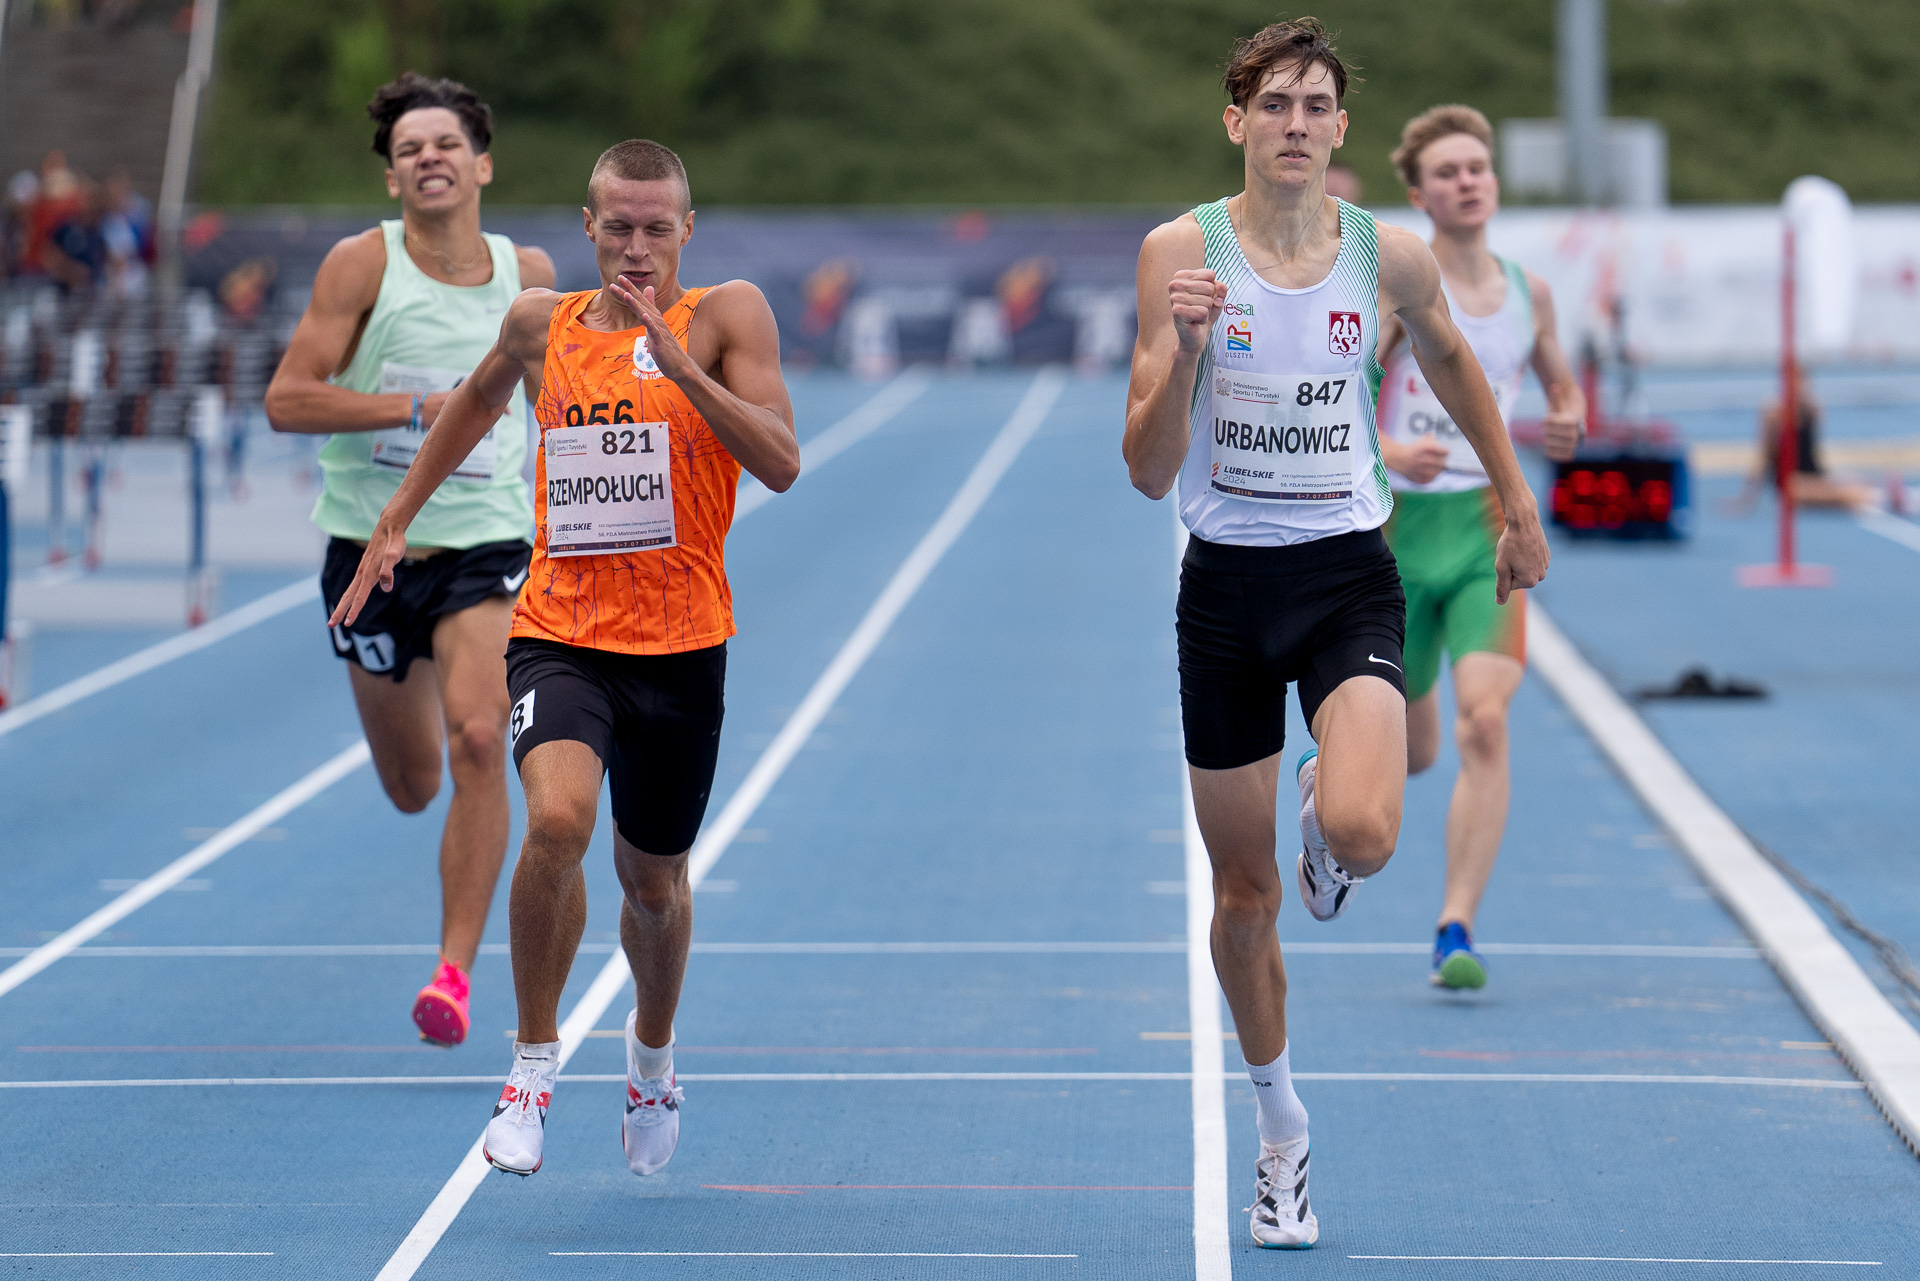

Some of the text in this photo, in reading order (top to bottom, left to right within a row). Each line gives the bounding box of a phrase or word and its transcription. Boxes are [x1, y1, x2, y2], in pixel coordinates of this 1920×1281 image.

[1232, 388, 1251, 397] Sportu
[1255, 391, 1280, 399] Turystyki
[1233, 382, 1269, 392] Ministerstwo
[1296, 379, 1347, 407] 847
[1408, 411, 1462, 440] CHO
[601, 429, 655, 455] 821
[1215, 417, 1351, 454] URBANOWICZ
[1224, 466, 1275, 479] LUBELSKIE
[1223, 474, 1246, 485] 2024
[549, 473, 664, 507] RZEMPOŁUCH
[1227, 488, 1253, 496] LUBLIN
[556, 523, 592, 532] LUBELSKIE
[555, 533, 569, 541] 2024
[512, 703, 525, 742] 8
